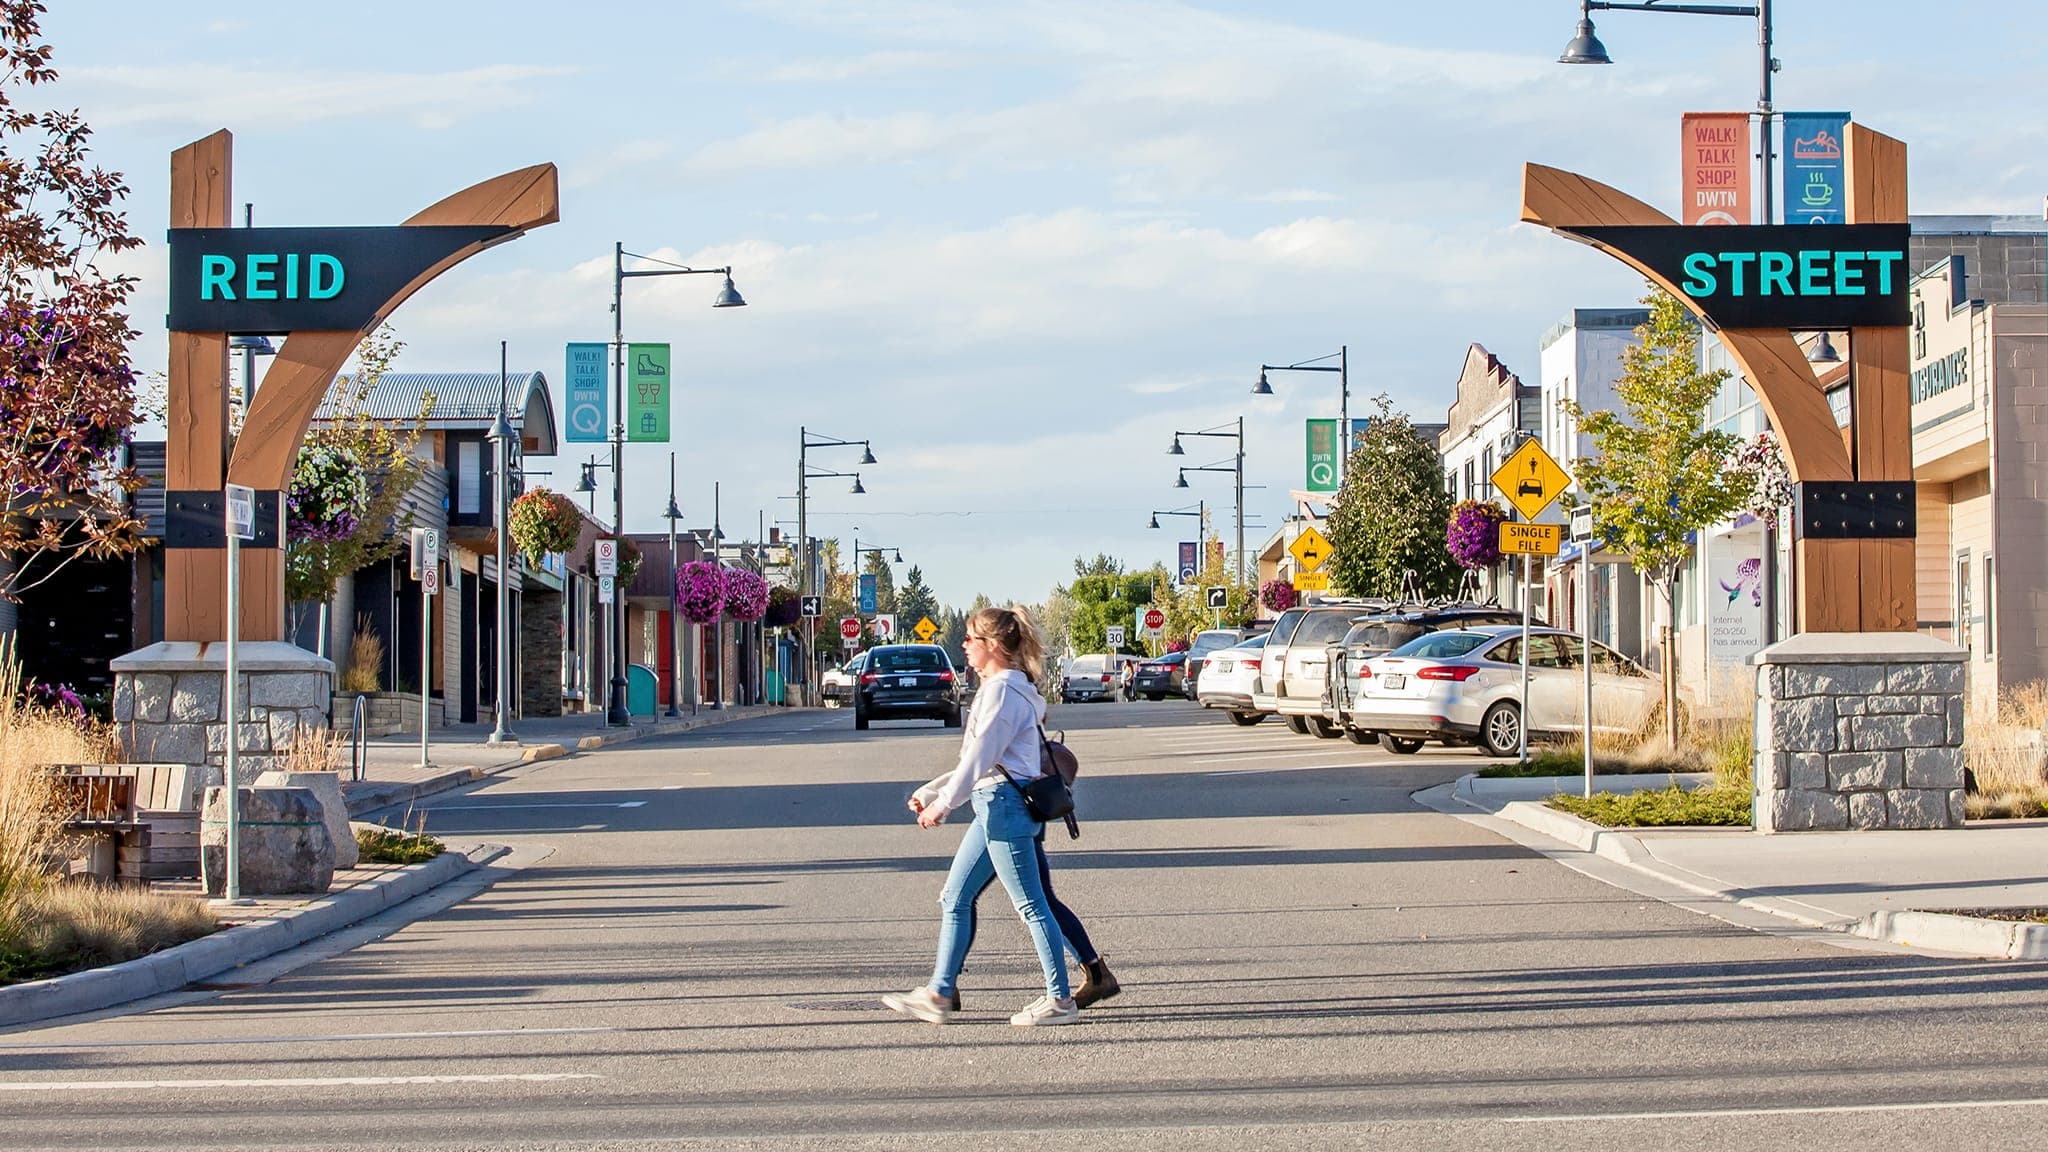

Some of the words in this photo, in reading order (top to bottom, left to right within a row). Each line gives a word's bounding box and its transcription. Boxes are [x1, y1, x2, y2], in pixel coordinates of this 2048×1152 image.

[1695, 127, 1737, 143] WALK!
[1697, 149, 1735, 164] TALK!
[1696, 169, 1737, 185] SHOP!
[1696, 190, 1737, 207] DWTN
[201, 253, 345, 300] REID
[1682, 250, 1904, 297] STREET
[574, 351, 600, 361] WALK!
[575, 365, 599, 375] TALK!
[1910, 346, 1968, 406] NSURANCE
[574, 378, 600, 388] SHOP!
[574, 390, 599, 401] DWTN
[572, 403, 601, 434] Q
[1312, 453, 1331, 462] DWTN
[1311, 463, 1333, 485] Q
[1510, 526, 1551, 539] SINGLE
[1518, 540, 1541, 551] FILE
[1146, 615, 1163, 624] STOP
[1713, 616, 1743, 624] Internet
[842, 624, 859, 633] STOP
[1109, 633, 1122, 644] 30
[1713, 637, 1728, 646] has
